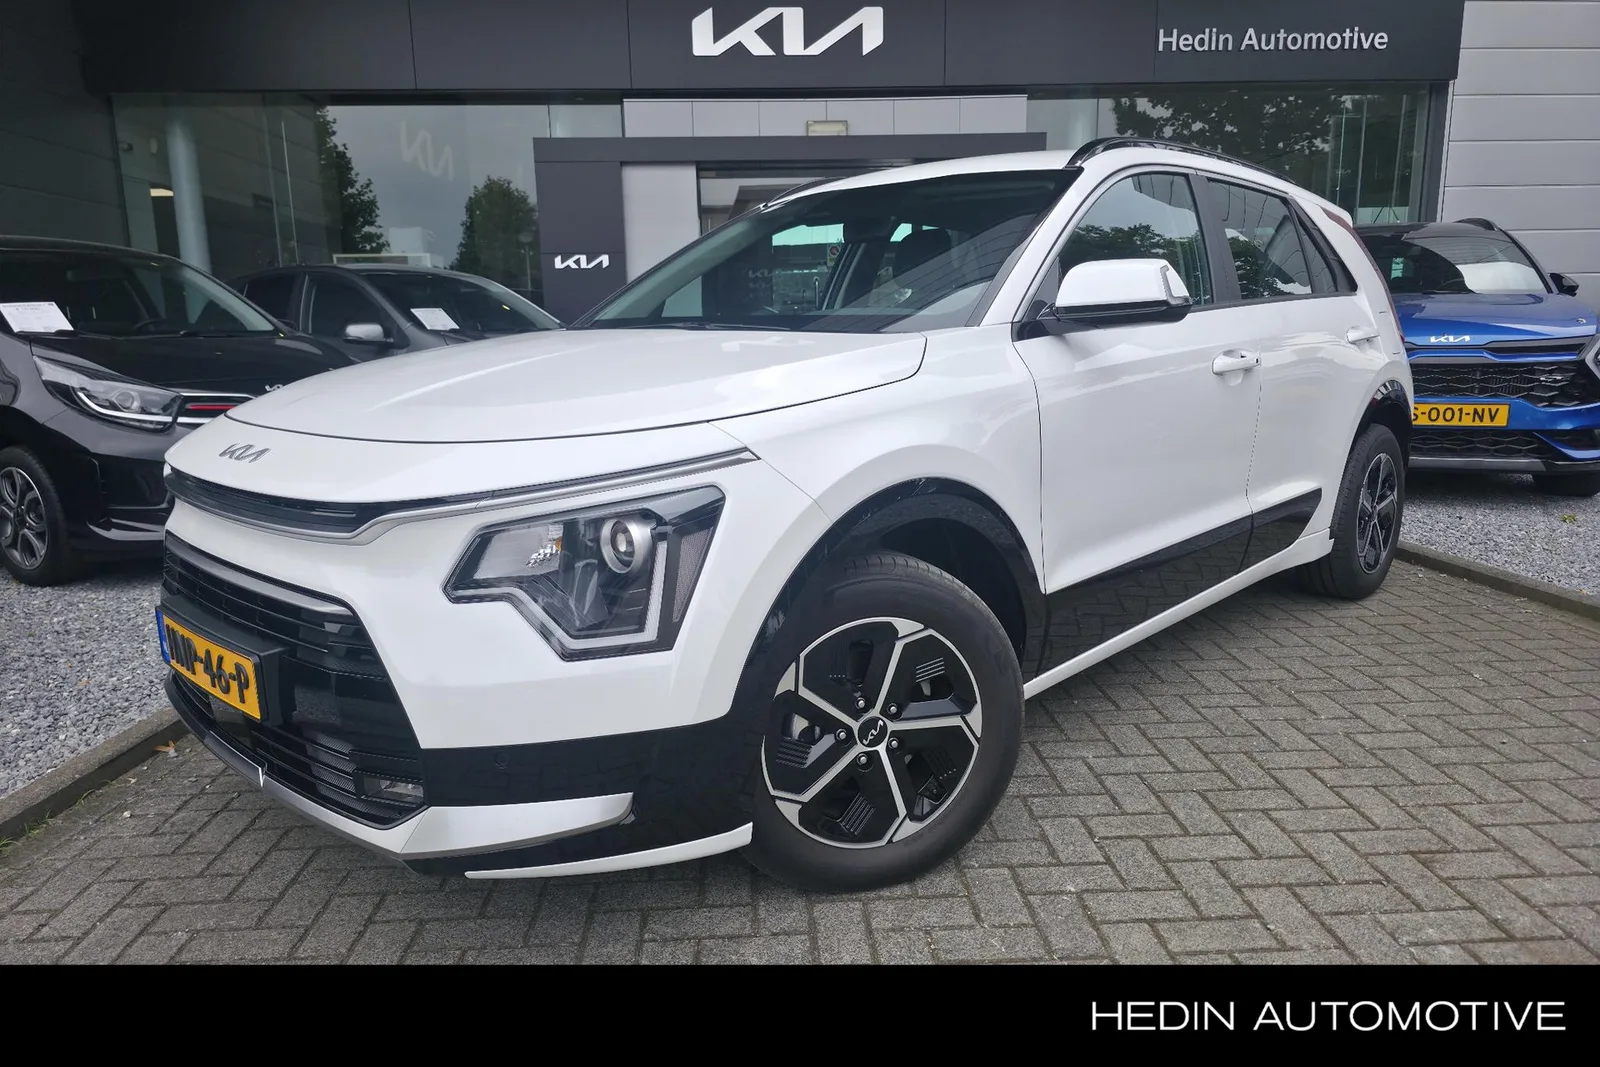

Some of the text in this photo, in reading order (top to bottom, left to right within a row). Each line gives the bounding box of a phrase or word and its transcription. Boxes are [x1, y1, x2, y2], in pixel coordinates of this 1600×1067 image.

[692, 6, 884, 56] KIA
[1157, 26, 1389, 52] Hedin Automotive
[554, 254, 609, 269] KIA
[1430, 335, 1470, 343] KIA
[218, 442, 271, 464] KIA
